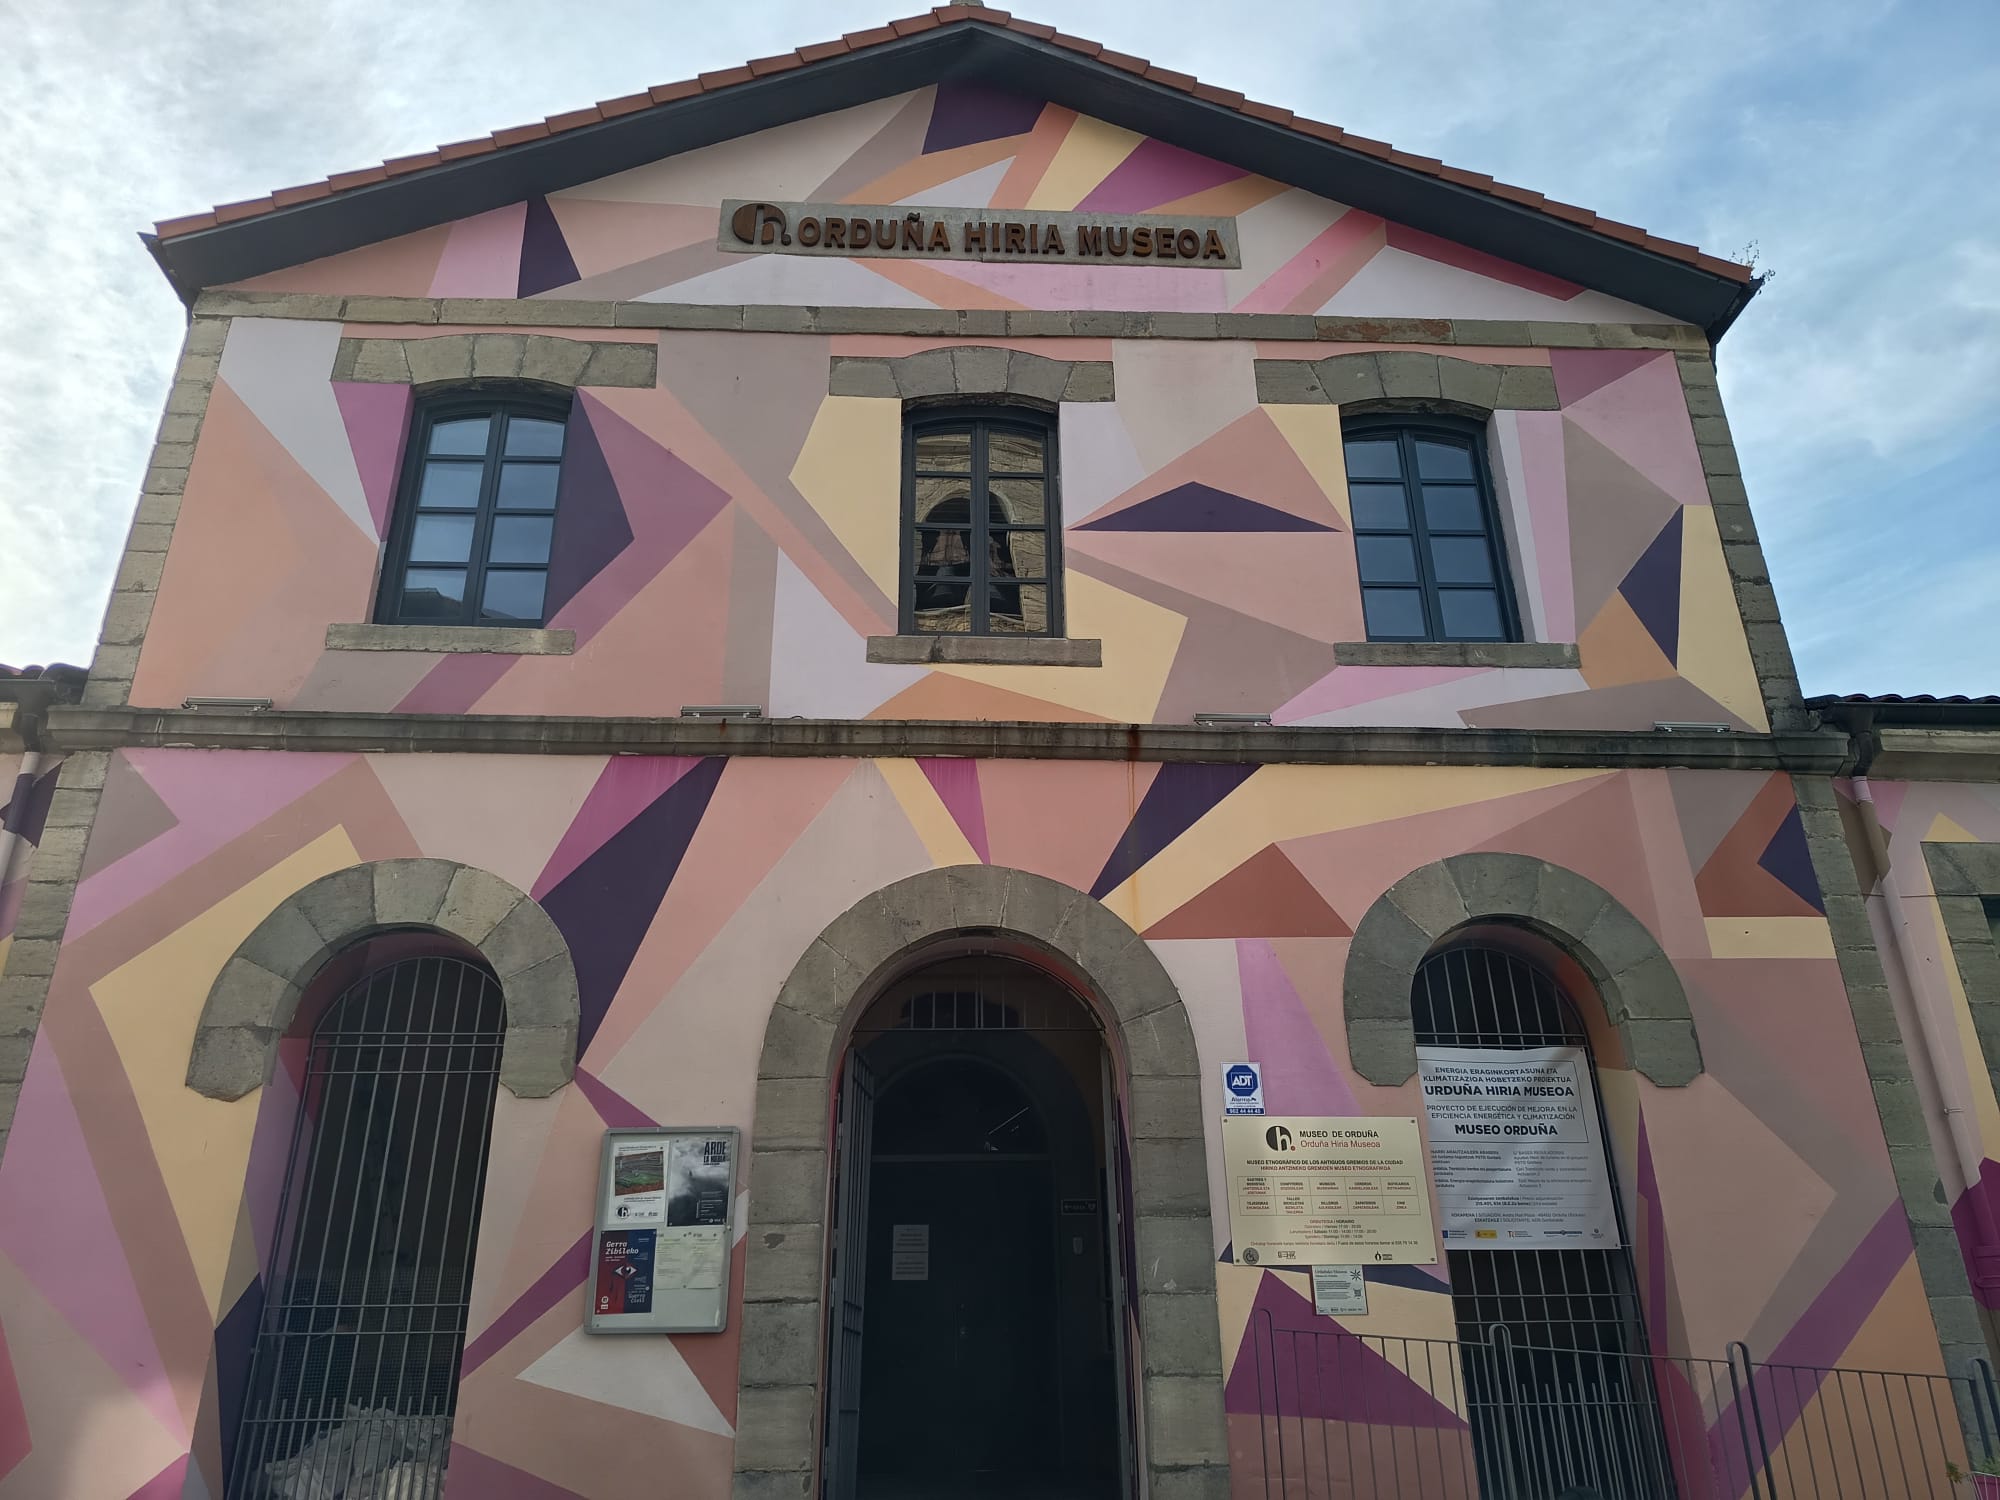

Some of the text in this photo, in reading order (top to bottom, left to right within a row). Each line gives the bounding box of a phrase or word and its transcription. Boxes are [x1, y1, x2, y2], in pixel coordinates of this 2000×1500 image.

[798, 212, 951, 252] ORDUÑA
[964, 221, 1065, 255] HIRIA
[1077, 225, 1227, 260] MUSEOA
[1470, 1067, 1545, 1075] ERAGINKORTASUNA
[1232, 1075, 1252, 1086] ADT
[1425, 1084, 1575, 1097] URDUÑA HIRIA MUSEOA
[1478, 1104, 1517, 1112] EJECUCIÓN
[1300, 1130, 1328, 1138] MUSEO
[1345, 1129, 1379, 1138] ORDUÑA
[1455, 1122, 1558, 1136] MUSEO ORDUÑA
[704, 1141, 726, 1155] ARDE
[1300, 1140, 1380, 1148] Orduña Hiria Museoa
